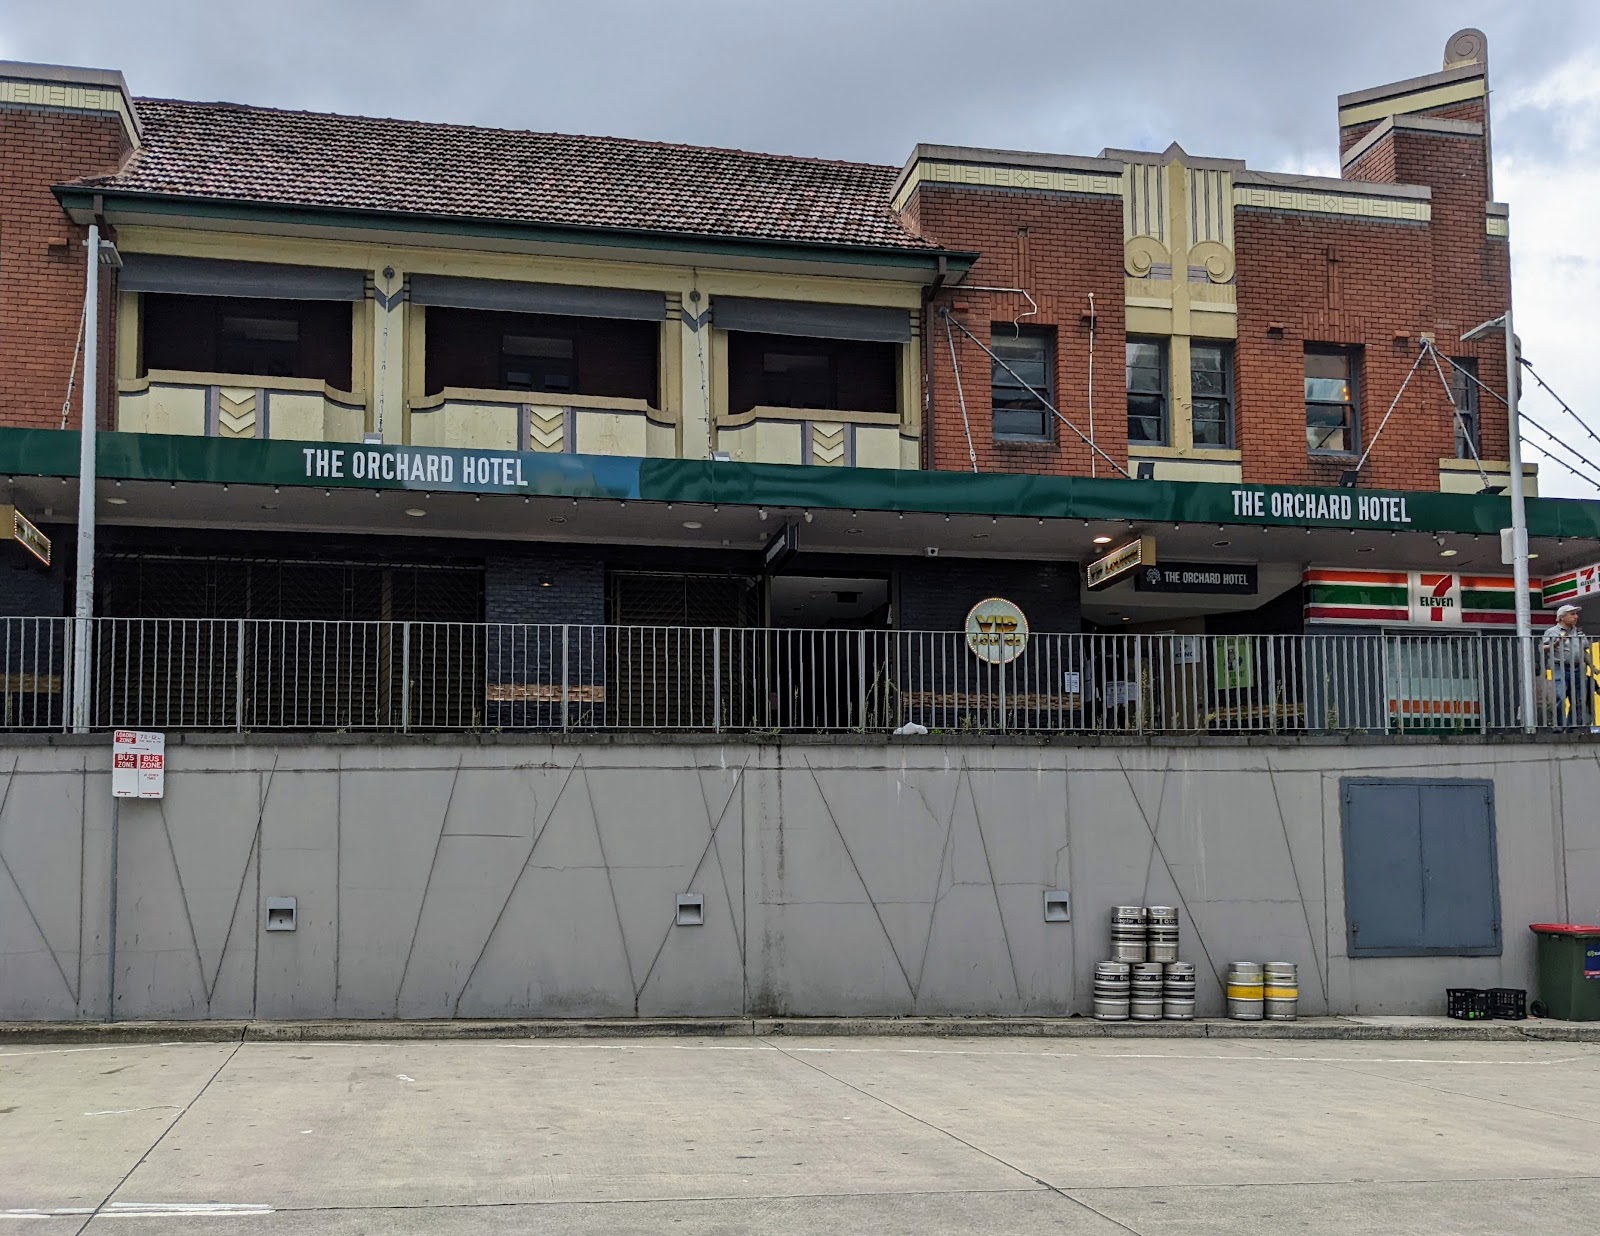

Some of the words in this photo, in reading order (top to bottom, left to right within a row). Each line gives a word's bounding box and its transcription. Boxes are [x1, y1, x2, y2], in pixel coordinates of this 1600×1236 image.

[303, 448, 345, 478] THE
[352, 451, 453, 483] ORCHARD
[463, 456, 529, 486] HOTEL
[1232, 490, 1265, 517] THE
[1271, 492, 1351, 520] ORCHARD
[1358, 496, 1412, 523] HOTEL
[1164, 571, 1181, 583] THE
[1182, 572, 1221, 584] ORCHARD
[1223, 573, 1249, 585] HOTEL
[1420, 574, 1453, 621] 7
[975, 614, 1018, 633] VIP
